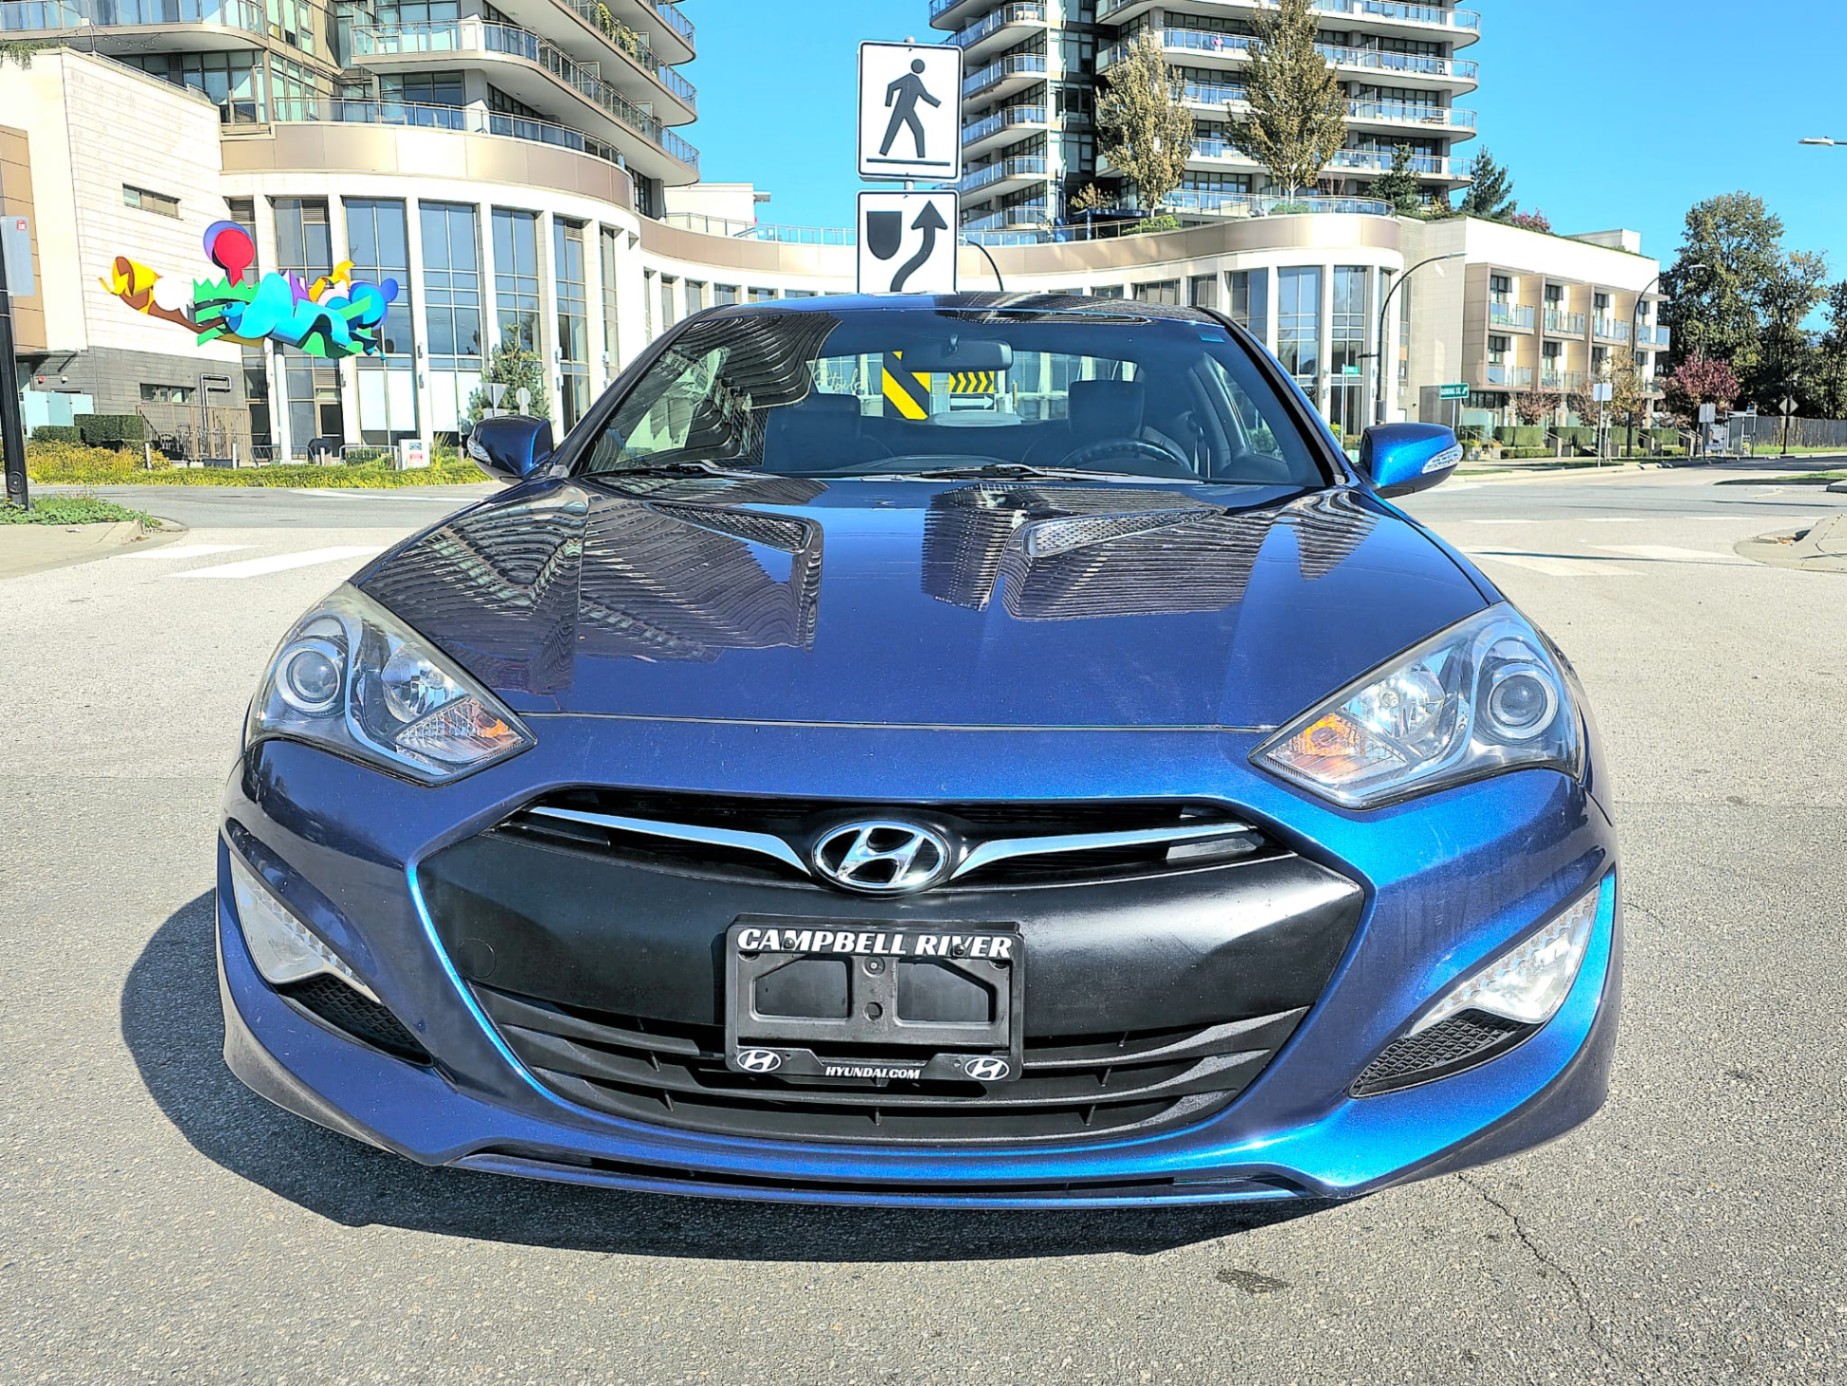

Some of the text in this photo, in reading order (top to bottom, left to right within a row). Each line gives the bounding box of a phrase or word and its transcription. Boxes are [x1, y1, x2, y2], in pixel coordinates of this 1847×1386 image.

[737, 928, 1012, 958] CAMPBELL RIVER
[825, 1066, 921, 1079] HYUNDAI.COM
